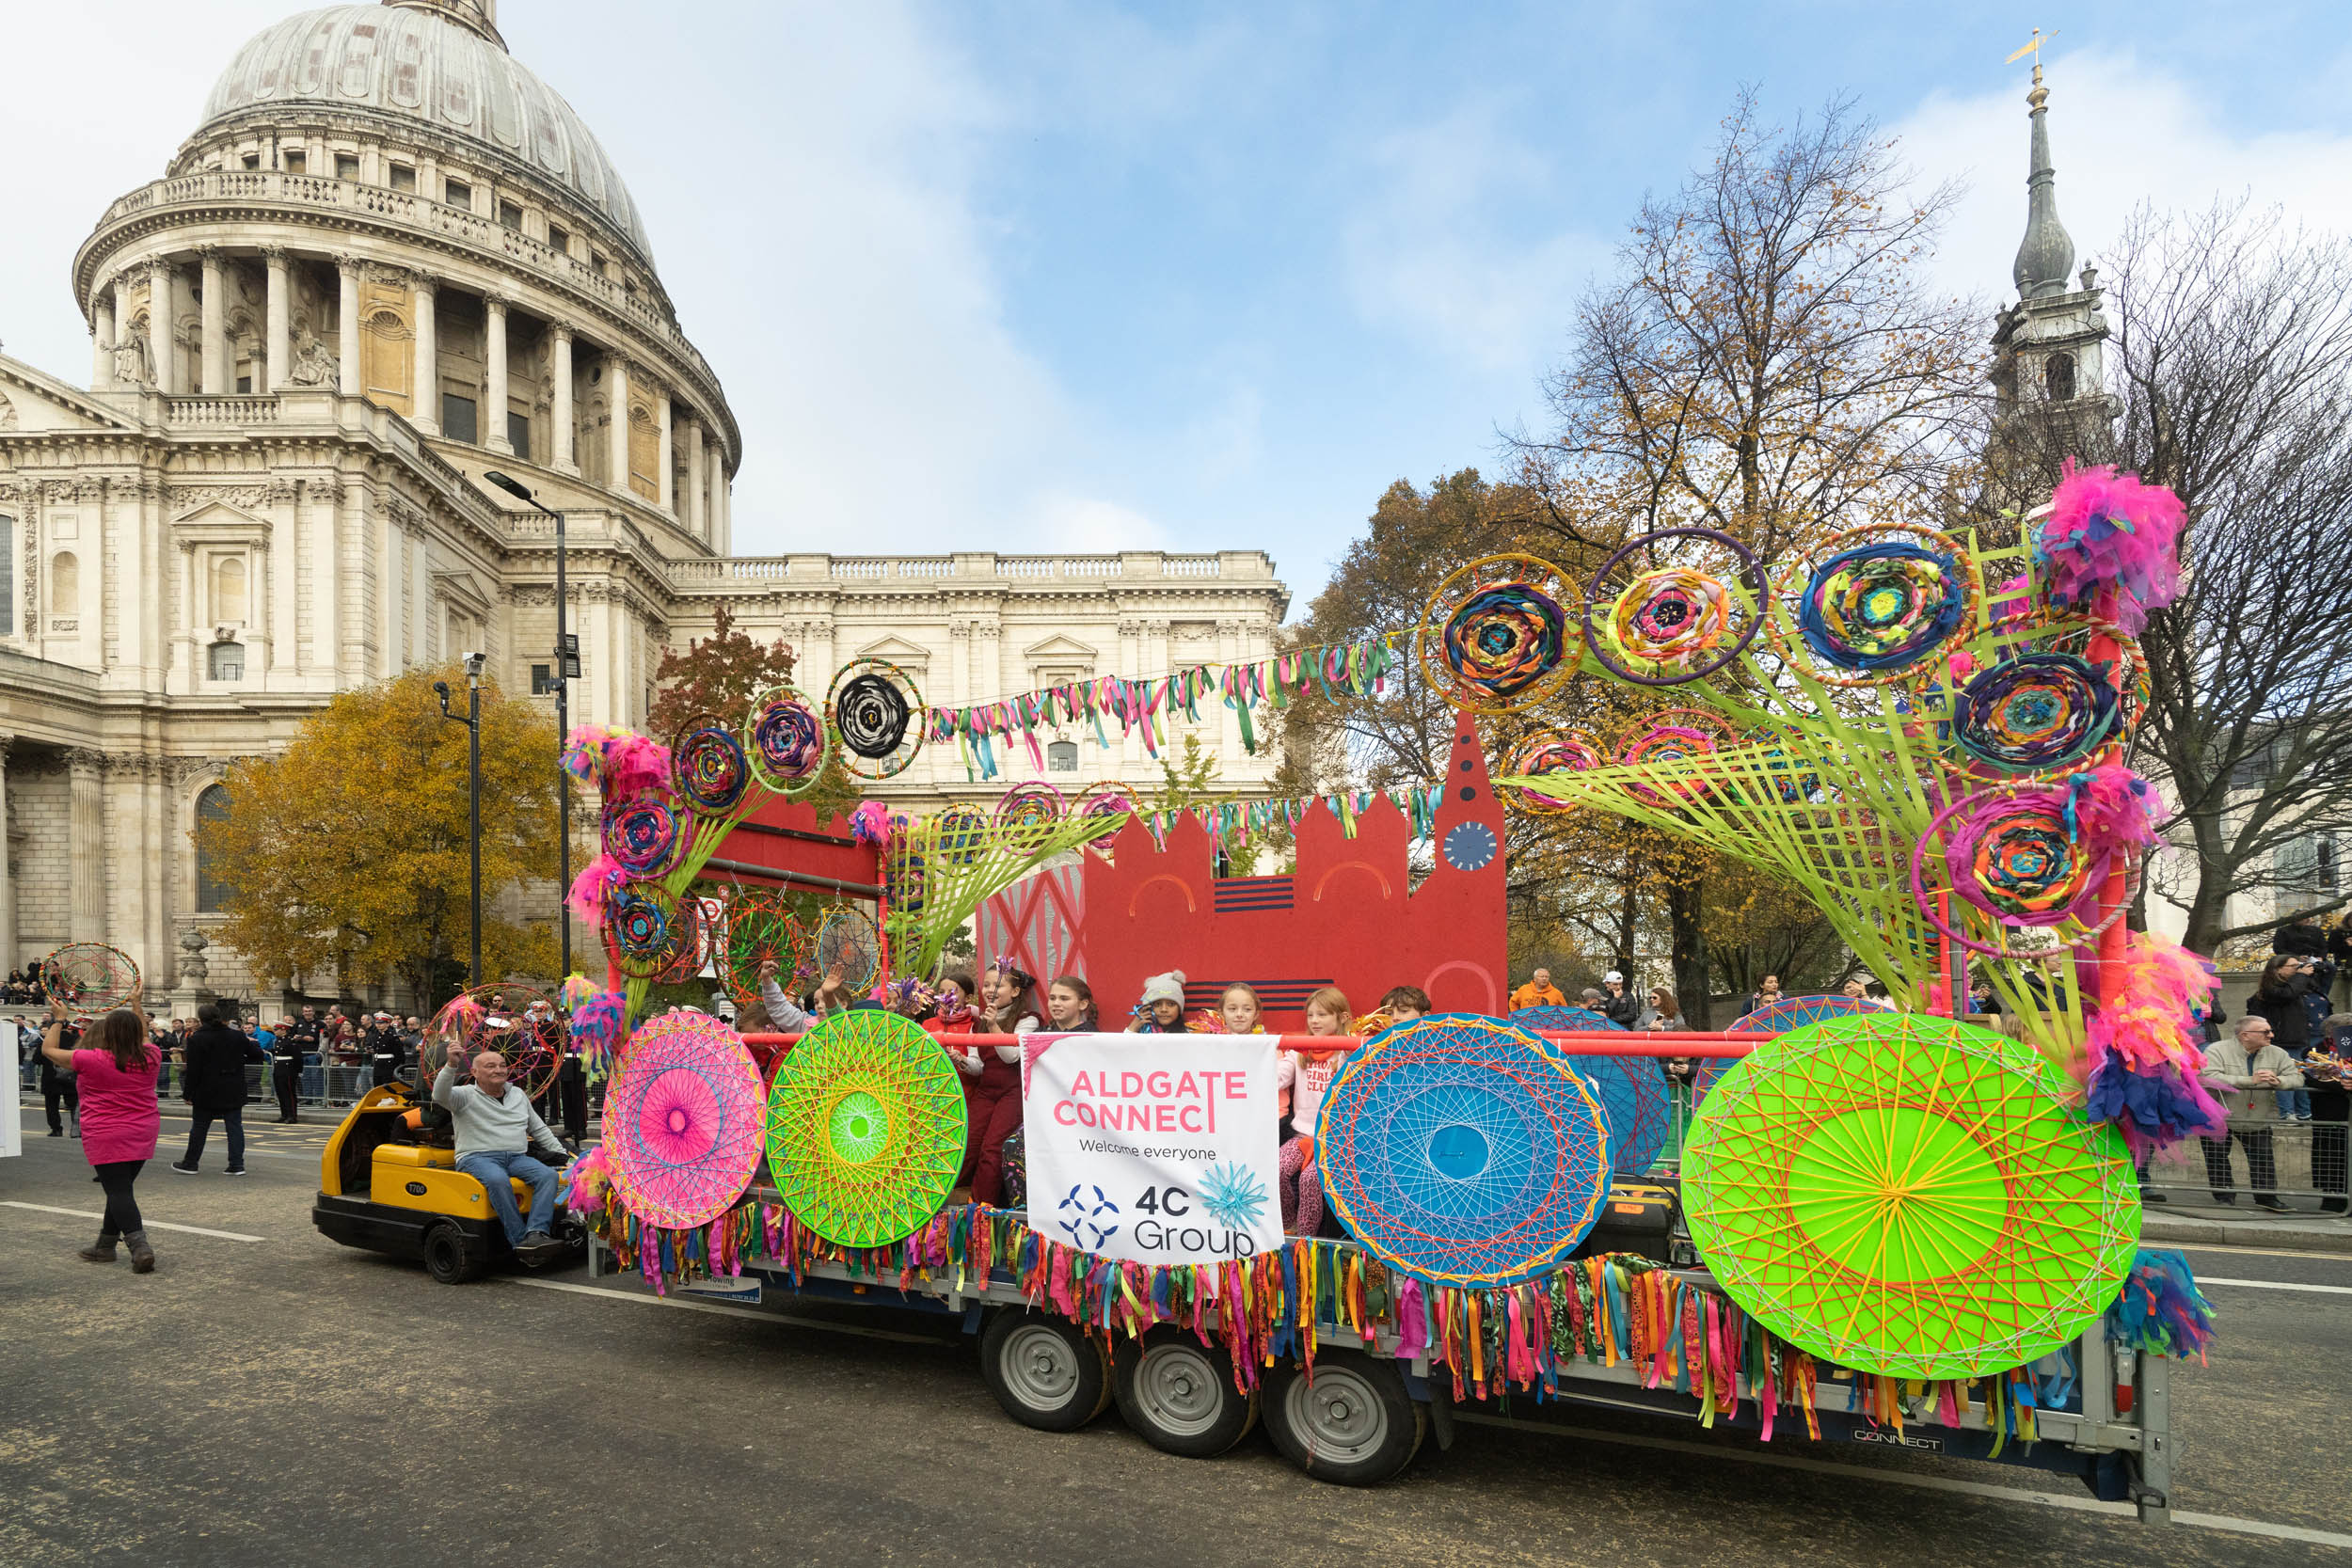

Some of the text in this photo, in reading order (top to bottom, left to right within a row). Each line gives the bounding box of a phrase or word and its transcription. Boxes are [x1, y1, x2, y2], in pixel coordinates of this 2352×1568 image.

[1071, 1070, 1248, 1100] ALDGATE
[1306, 1070, 1336, 1083] GIRLS
[1307, 1082, 1329, 1093] CLU
[1054, 1100, 1216, 1133] CONNECT
[1079, 1139, 1216, 1161] Welcome everyone
[1136, 1186, 1190, 1216] 4C
[1135, 1220, 1255, 1259] Group
[1854, 1430, 1940, 1449] CONNECT
